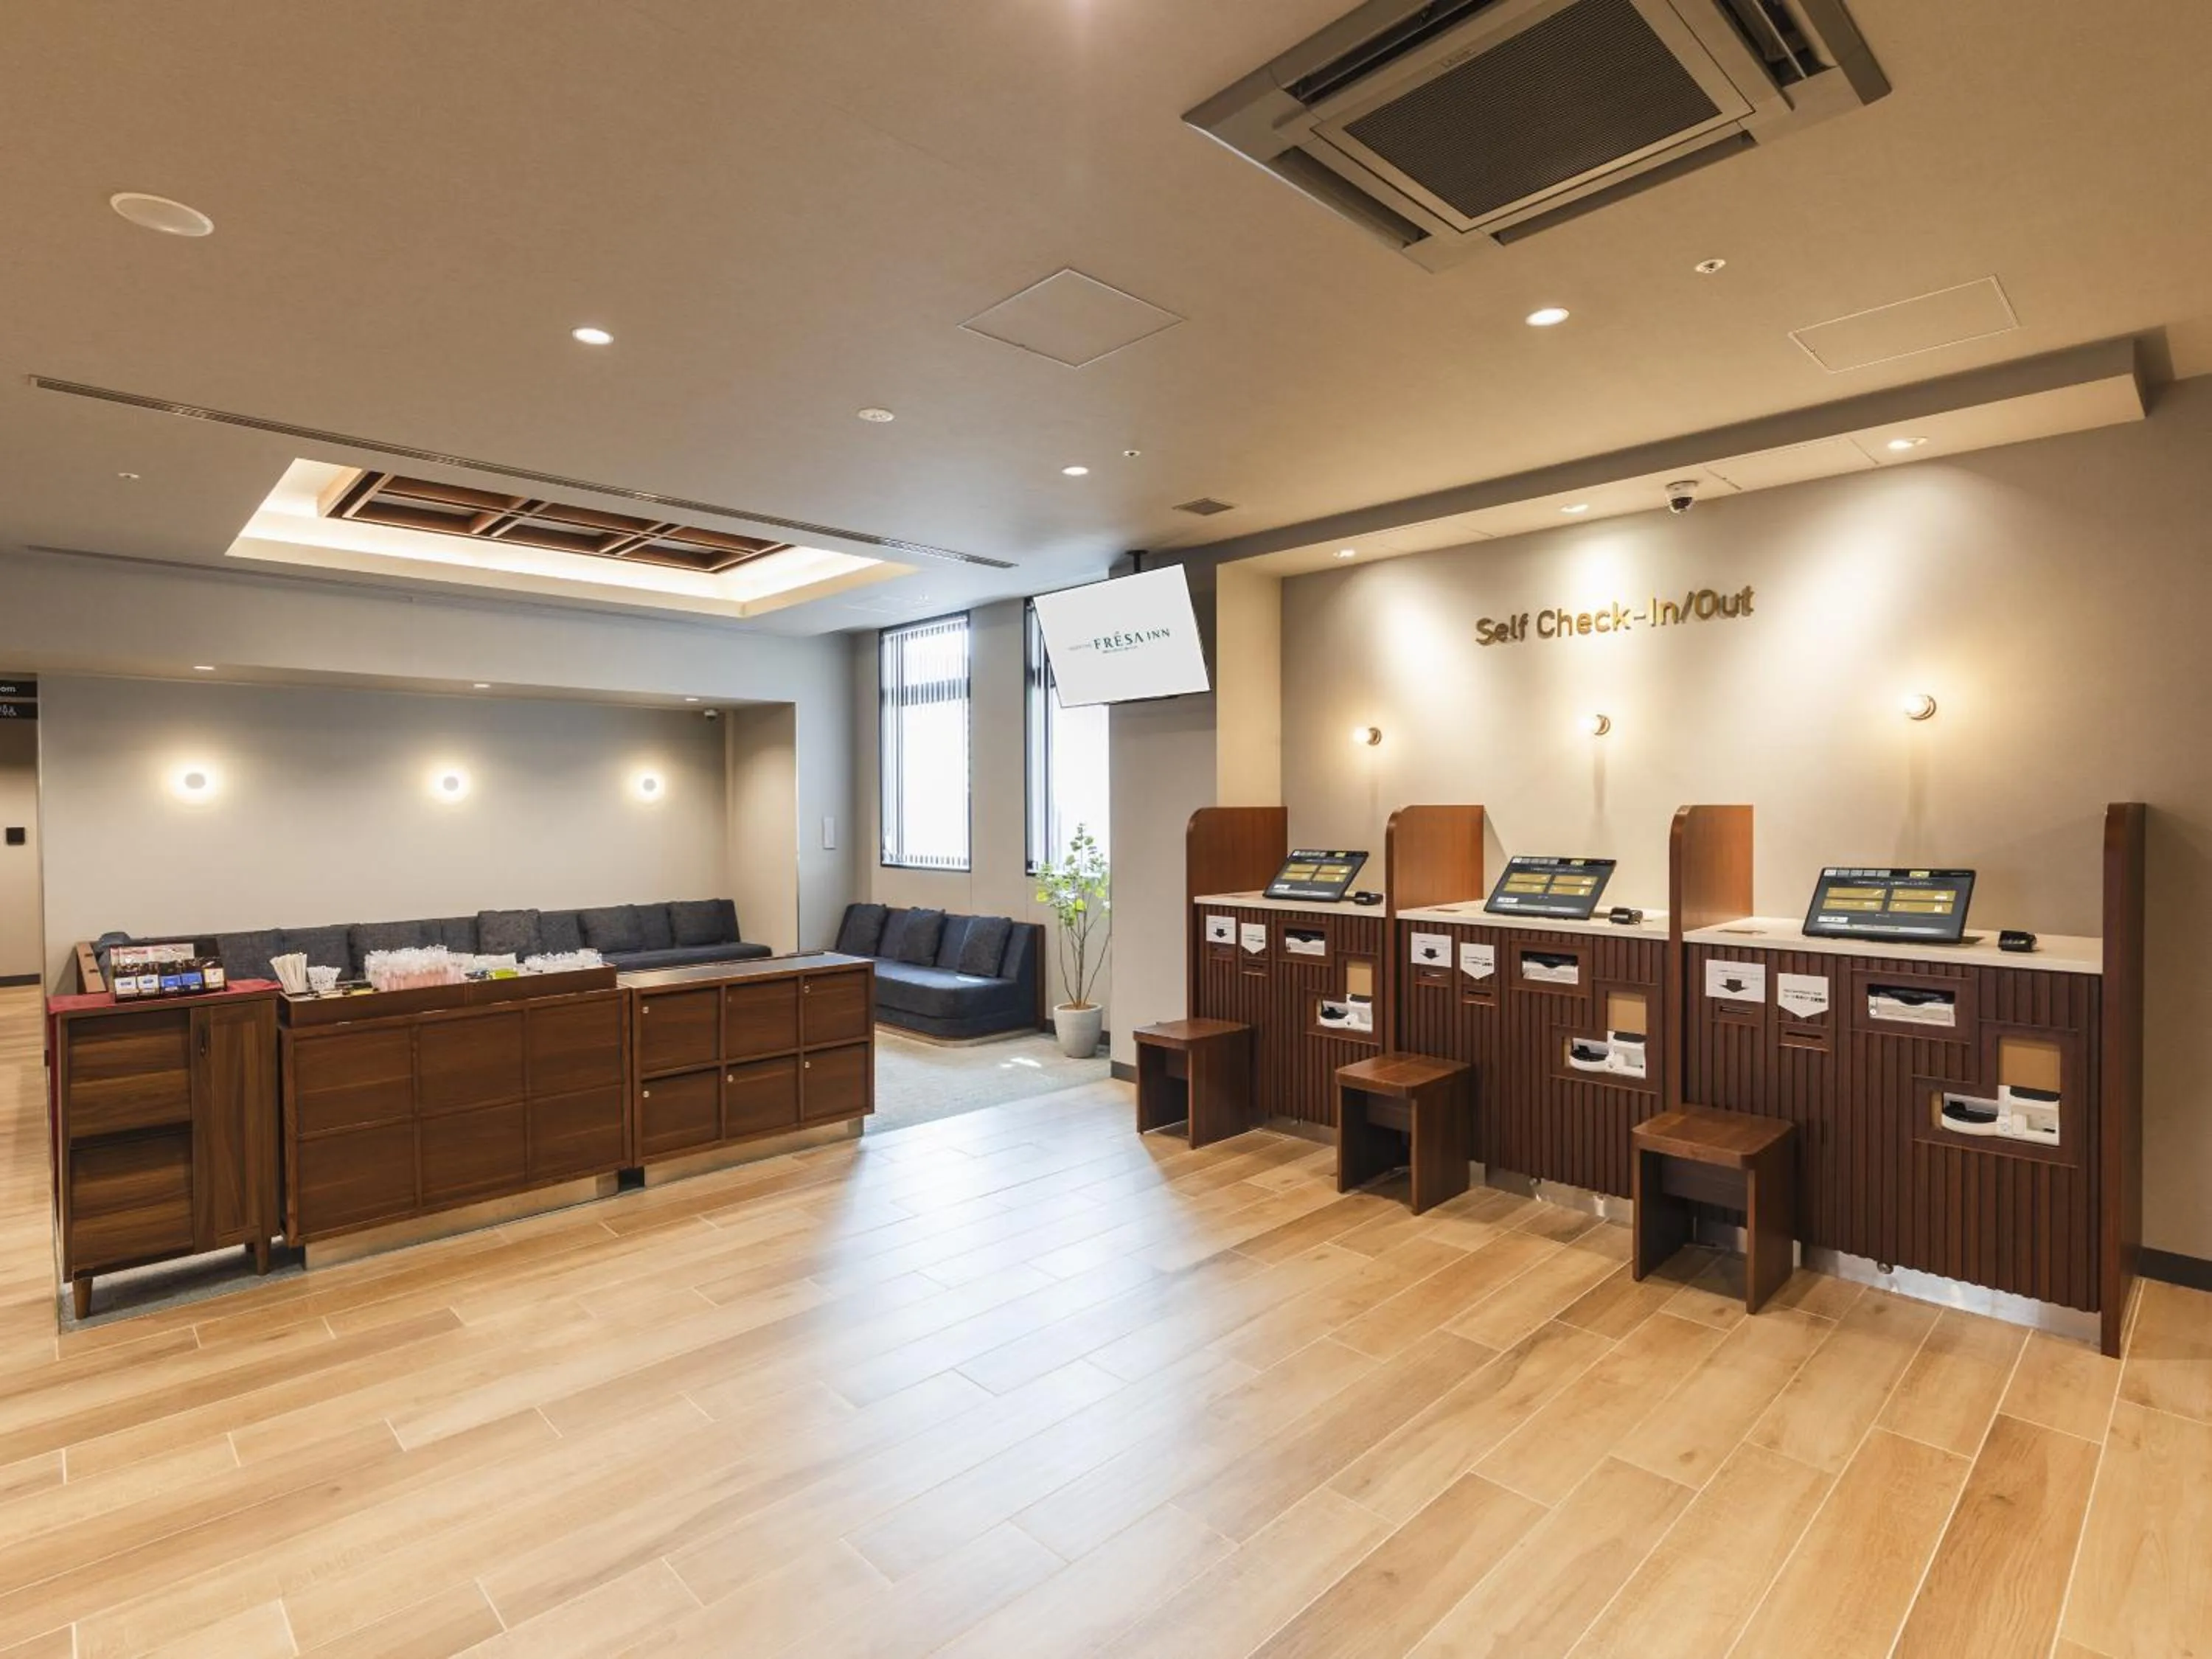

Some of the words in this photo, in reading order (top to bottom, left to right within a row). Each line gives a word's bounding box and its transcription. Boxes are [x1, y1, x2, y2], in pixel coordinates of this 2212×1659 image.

[1146, 627, 1170, 641] INN
[1475, 613, 1529, 646] Self
[1536, 585, 1756, 639] Check-In/Out
